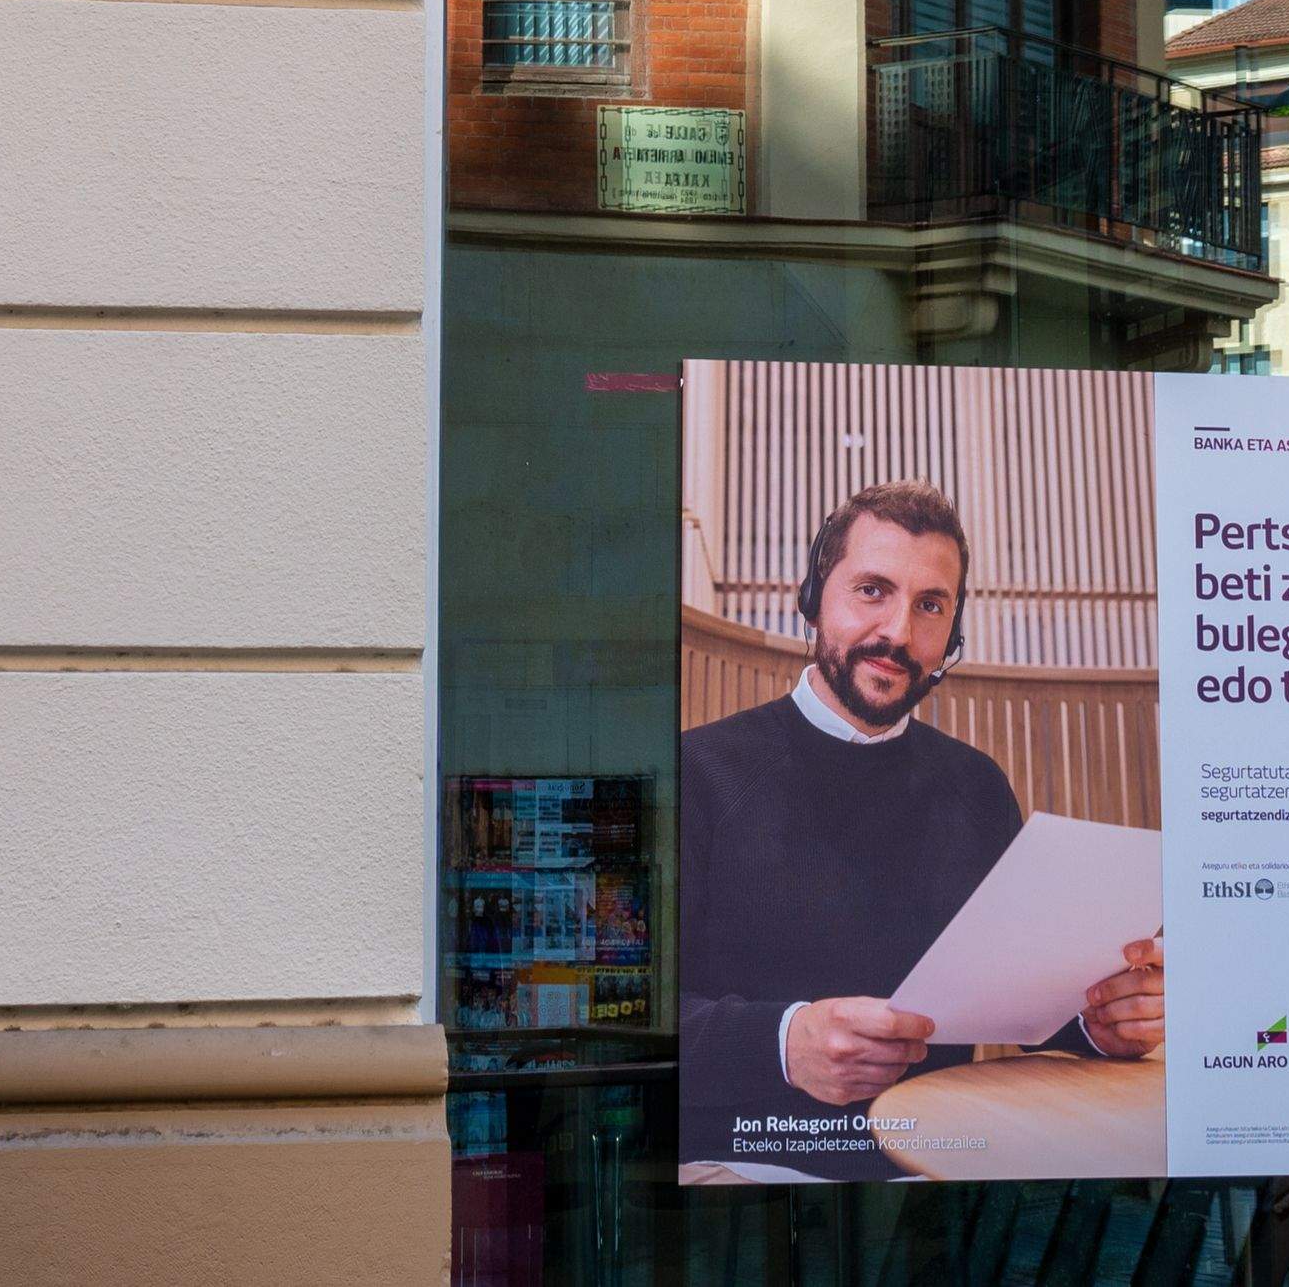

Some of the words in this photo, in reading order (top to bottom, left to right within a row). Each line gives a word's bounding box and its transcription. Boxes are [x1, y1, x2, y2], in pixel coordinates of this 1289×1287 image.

[1195, 438, 1243, 450] BANKA
[1248, 439, 1273, 451] ETA
[1196, 563, 1270, 601] beti
[1197, 666, 1272, 703] edo
[1203, 882, 1251, 897] EthSI
[1204, 1056, 1253, 1068] LAGUN
[1258, 1056, 1287, 1068] ARO
[733, 1117, 761, 1132] Jon
[767, 1115, 847, 1134] Rekagorri
[853, 1116, 917, 1130] Ortuzar
[733, 1137, 782, 1153] Etxeko
[786, 1136, 875, 1155] Izapidetzeen
[879, 1135, 986, 1151] Koordinatzailea
